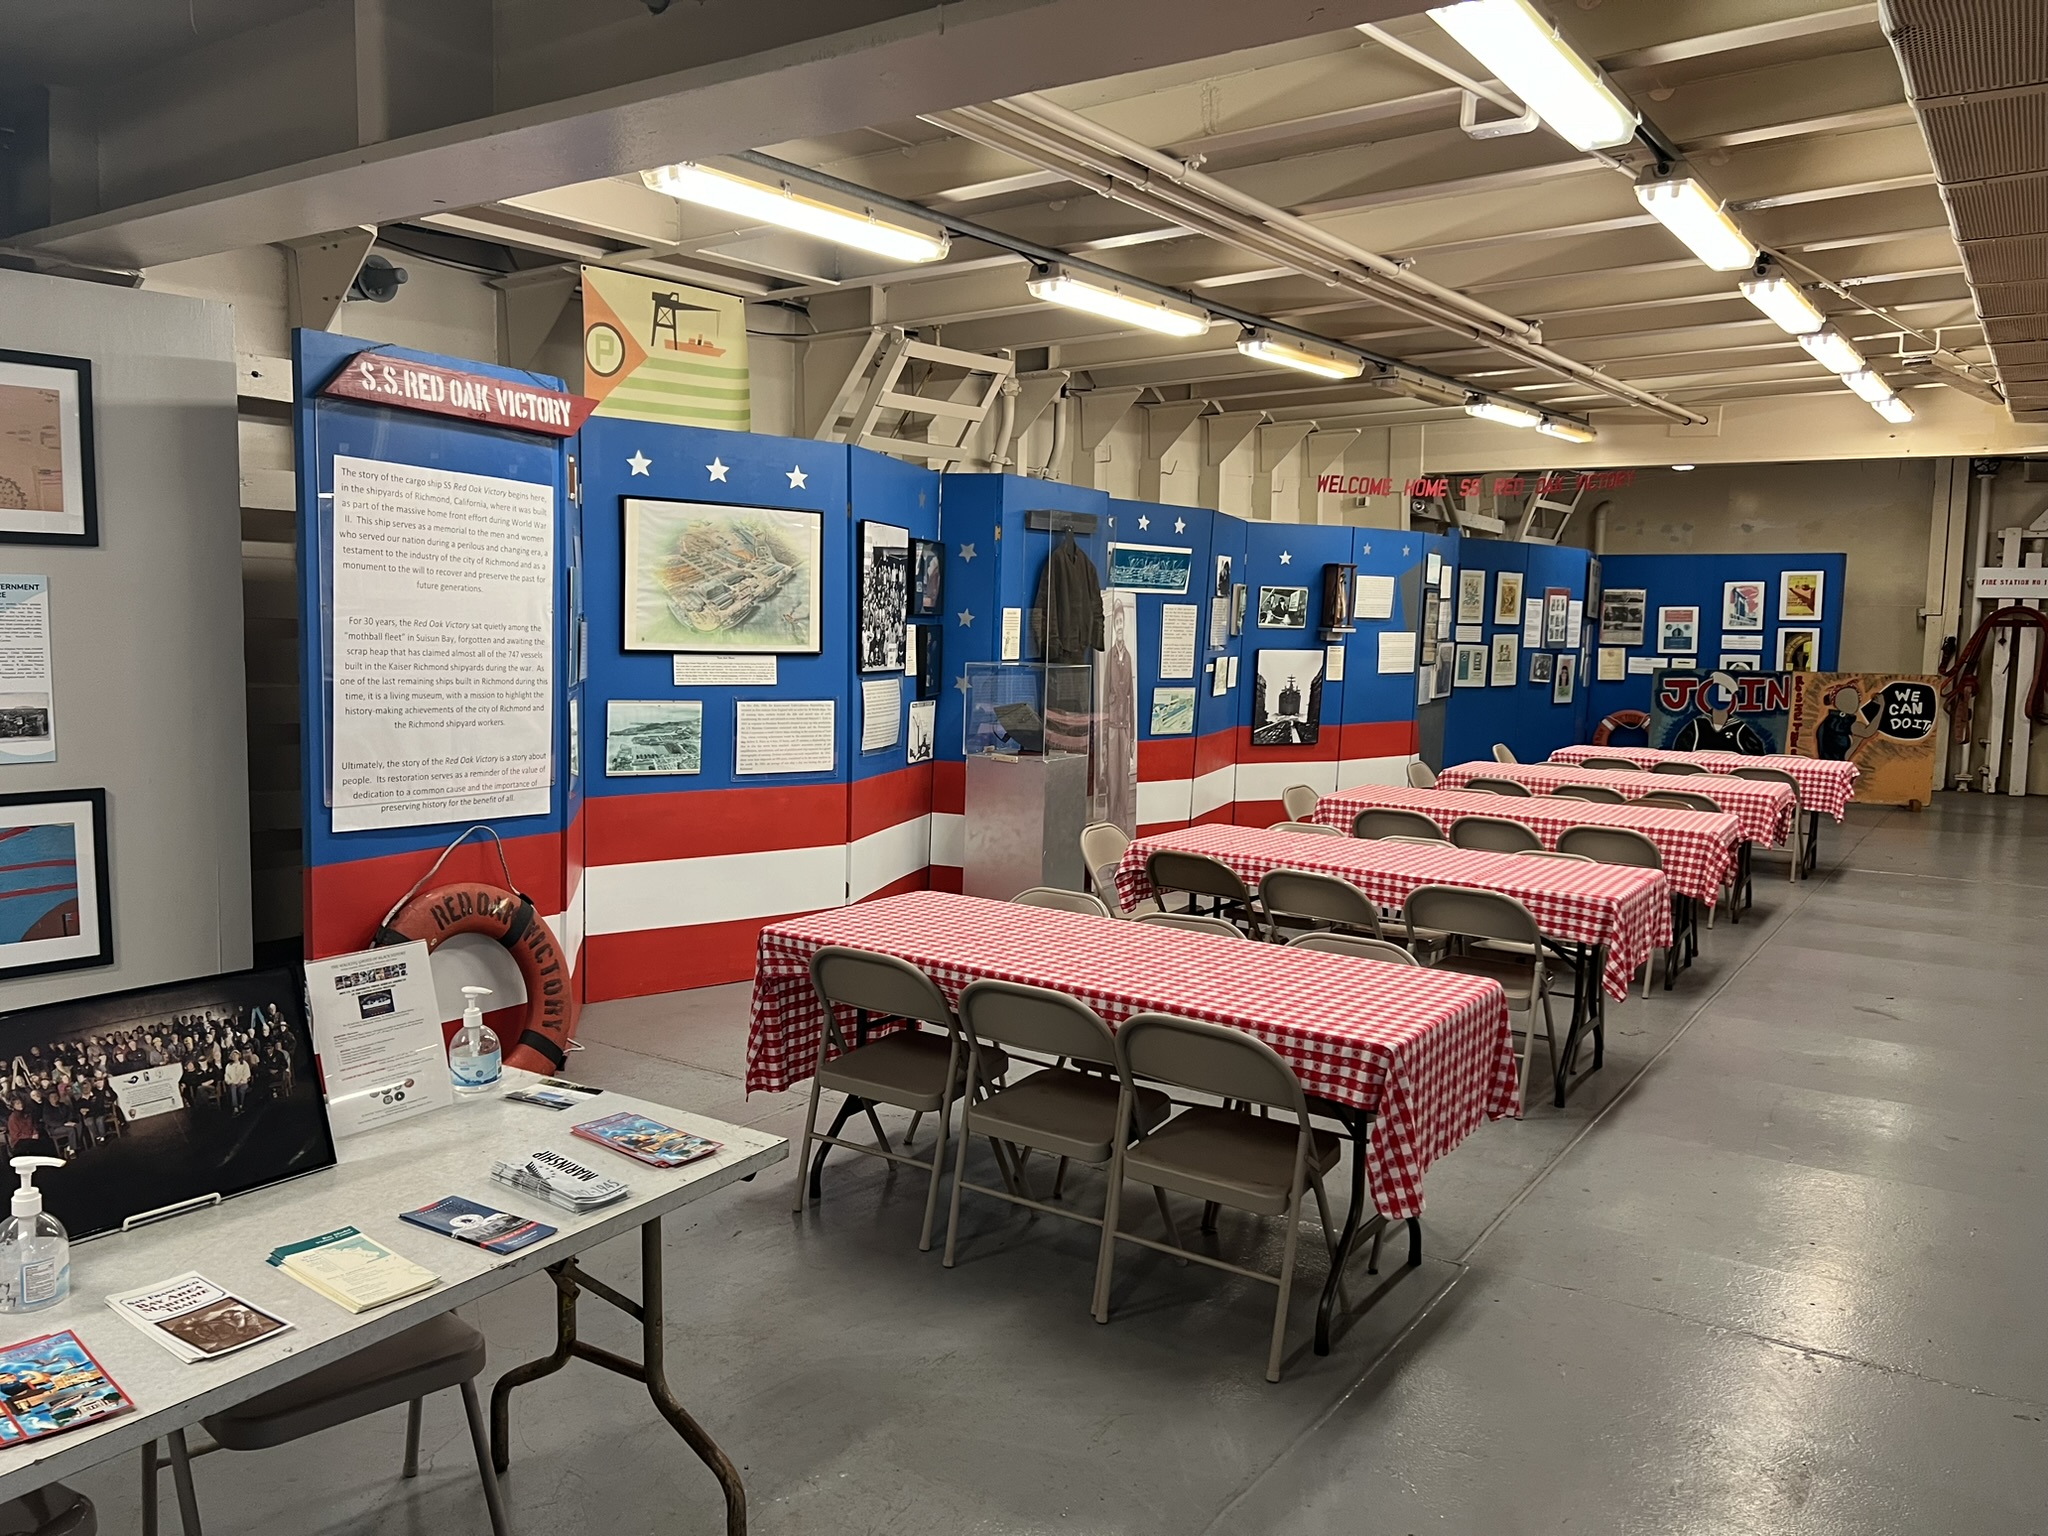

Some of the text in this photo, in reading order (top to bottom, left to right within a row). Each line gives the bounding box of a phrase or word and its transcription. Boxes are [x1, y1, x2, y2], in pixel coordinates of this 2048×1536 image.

[595, 333, 615, 366] P
[403, 369, 445, 403] RED
[450, 378, 491, 413] OAK
[495, 387, 571, 427] VICTORY
[341, 467, 357, 477] The
[358, 470, 380, 481] story
[380, 472, 389, 481] of
[390, 473, 404, 483] the
[405, 477, 426, 488] cargo
[427, 478, 442, 490] ship
[443, 480, 452, 490] SS
[453, 482, 468, 492] Red
[468, 484, 482, 494] Oak
[484, 486, 507, 498] Victory
[508, 489, 529, 501] begins
[1317, 475, 1392, 496] WELCOME
[1404, 478, 1449, 497] HOME
[1459, 478, 1481, 496] SS
[1493, 477, 1525, 496] RED
[341, 483, 350, 492] in
[350, 484, 365, 493] the
[366, 485, 404, 499] shipyards
[404, 490, 413, 499] of
[490, 501, 511, 511] where
[512, 504, 517, 512] it
[532, 506, 547, 516] built
[0, 583, 39, 591] ERNMENT
[348, 616, 363, 625] For
[363, 617, 374, 625] 30
[399, 618, 412, 627] the
[413, 619, 428, 627] Red
[429, 619, 444, 628] Oak
[445, 620, 470, 630] Victory
[471, 622, 482, 630] sat
[483, 622, 507, 632] quietly
[508, 625, 529, 633] among
[530, 623, 542, 632] the
[416, 634, 440, 642] Suisun
[458, 635, 492, 645] forgotten
[493, 636, 506, 644] and
[506, 637, 534, 646] awaiting
[534, 637, 545, 645] the
[369, 647, 390, 657] heap
[390, 648, 406, 656] that
[407, 648, 421, 656] has
[421, 648, 450, 657] claimed
[451, 649, 476, 657] almost
[476, 649, 486, 657] all
[486, 649, 495, 657] of
[495, 650, 507, 658] the
[508, 649, 520, 657] 747
[520, 650, 543, 659] vessels
[344, 662, 363, 670] built
[374, 662, 387, 670] the
[388, 662, 412, 670] Kaiser
[413, 662, 449, 671] Richmond
[450, 663, 485, 673] shipyards
[485, 663, 507, 673] during
[508, 663, 518, 671] the
[536, 664, 544, 672] As
[356, 676, 366, 684] of
[397, 677, 434, 686] remaining
[435, 677, 454, 686] ships
[455, 677, 472, 685] built
[481, 677, 514, 685] Richmond
[515, 677, 536, 686] during
[536, 677, 548, 685] this
[390, 691, 410, 701] living
[445, 691, 463, 699] with
[505, 690, 533, 700] highlight
[533, 690, 544, 698] the
[1660, 675, 1790, 716] JOIN
[1894, 688, 1921, 702] WE
[344, 703, 544, 716] history-making achievements of the city of Richmond and
[1889, 702, 1923, 716] CAN
[394, 720, 407, 728] the
[407, 719, 444, 728] Richmond
[446, 719, 476, 728] shipyard
[1890, 718, 1911, 730] DO
[386, 759, 400, 767] the
[402, 759, 420, 768] story
[421, 757, 430, 766] of
[431, 757, 444, 765] the
[445, 756, 460, 764] Red
[460, 755, 474, 764] Oak
[474, 754, 498, 764] Victory
[499, 754, 505, 762] is
[511, 753, 528, 762] story
[528, 752, 546, 760] about
[430, 892, 473, 930] RED
[523, 918, 564, 1033] VICTORY
[532, 1151, 599, 1181] MARINSHIP
